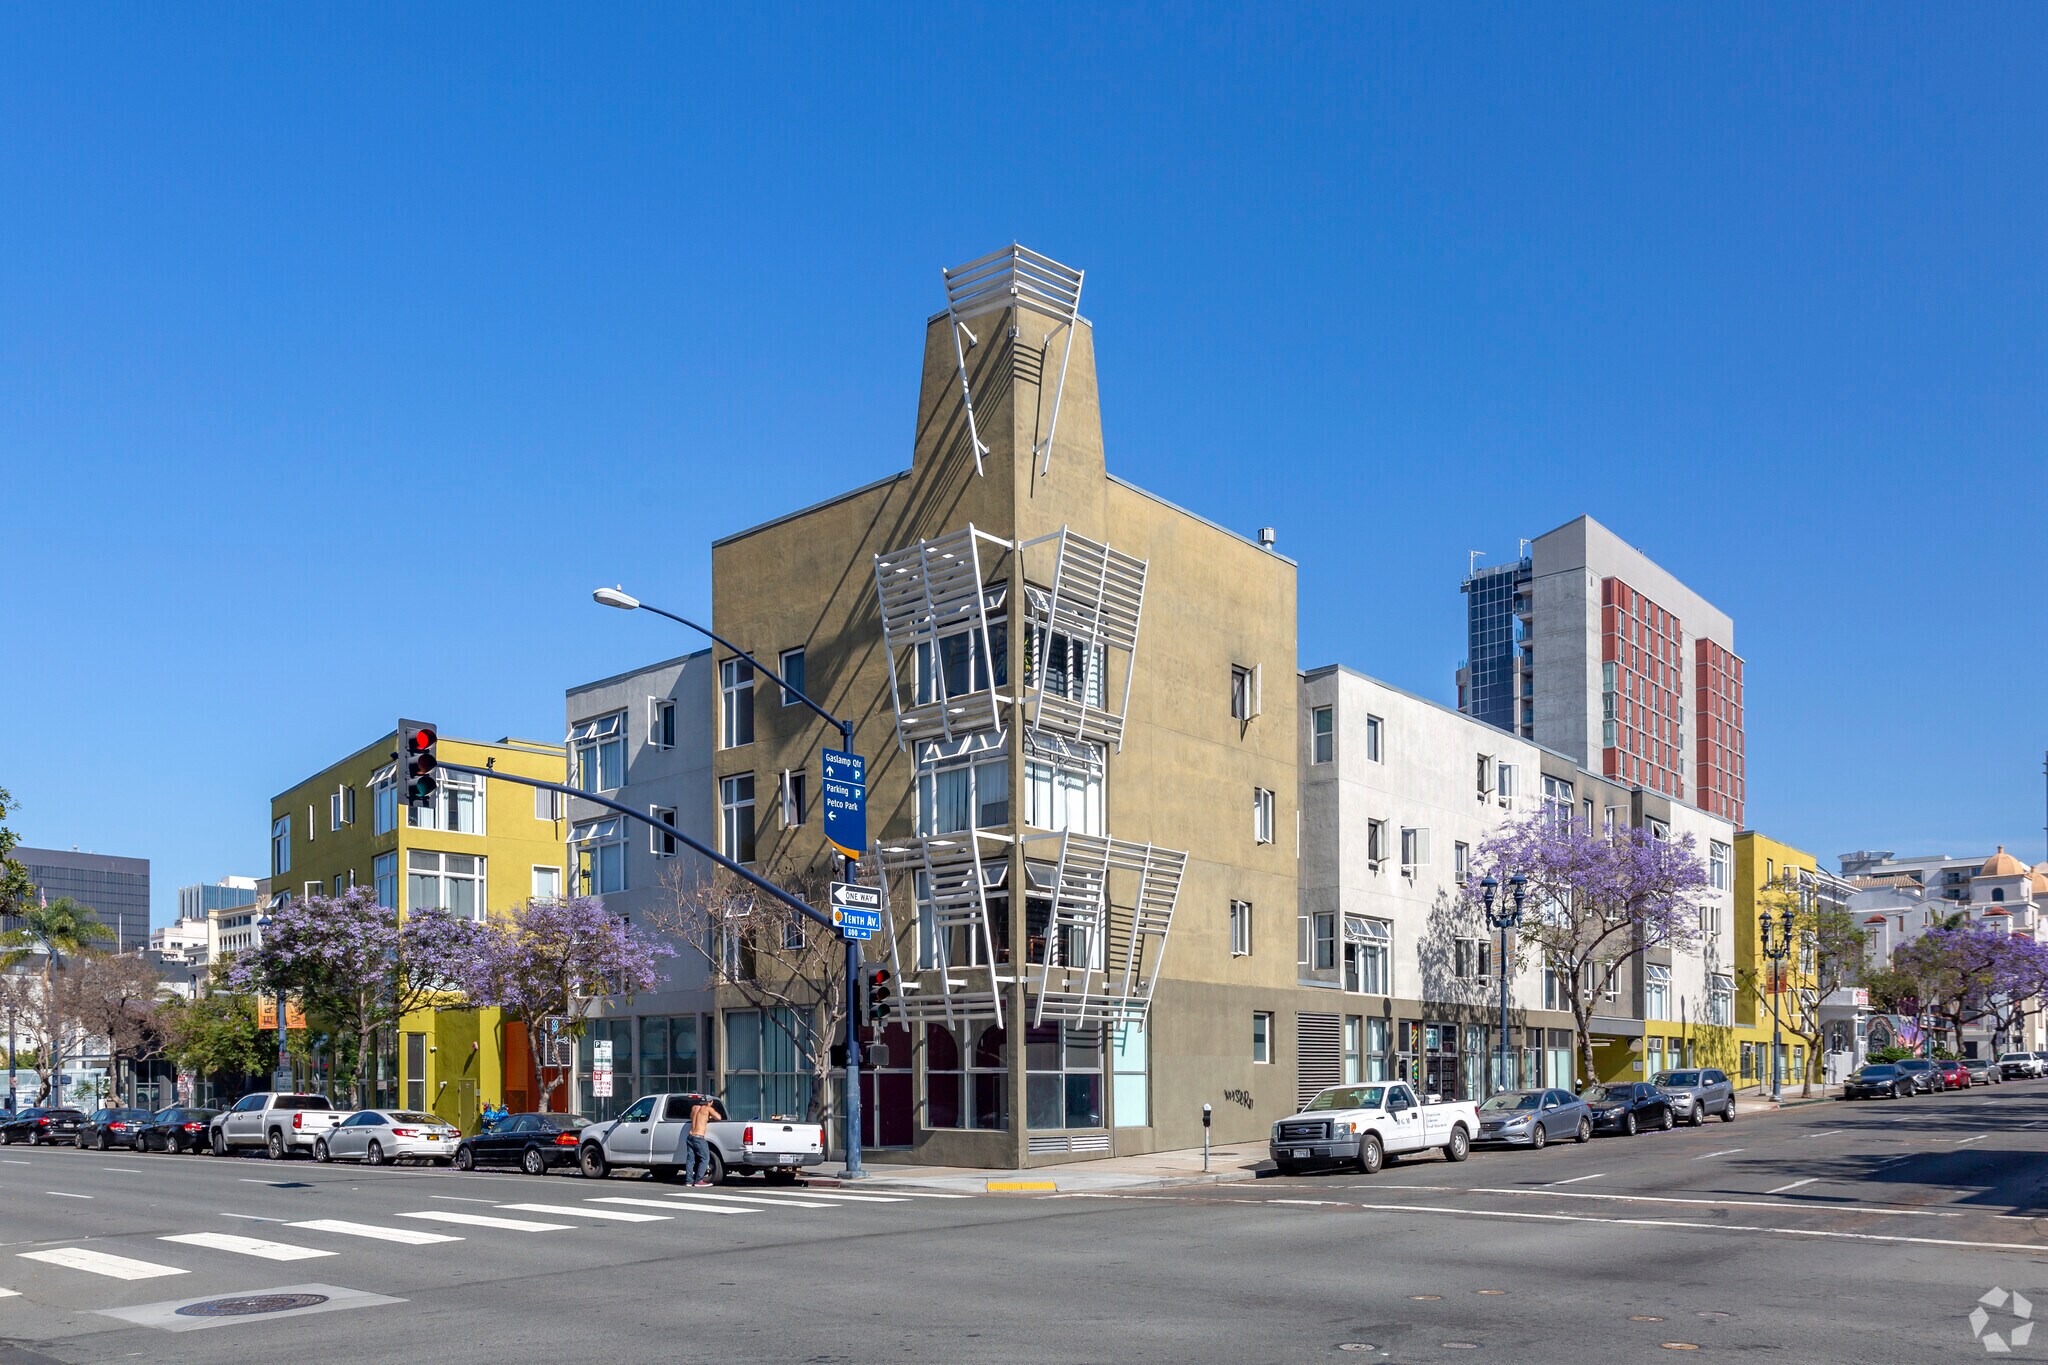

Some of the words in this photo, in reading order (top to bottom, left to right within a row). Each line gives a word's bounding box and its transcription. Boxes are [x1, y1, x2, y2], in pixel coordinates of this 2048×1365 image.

[825, 753, 851, 768] Gaslamp
[852, 758, 862, 768] Qtr
[854, 770, 860, 780] P
[826, 783, 849, 797] Parking
[855, 788, 861, 799] P
[827, 797, 844, 808] Petco
[844, 801, 859, 811] Park
[845, 891, 859, 900] ONE
[860, 894, 873, 902] WAY
[843, 912, 865, 925] TENTH
[847, 928, 859, 937] 800
